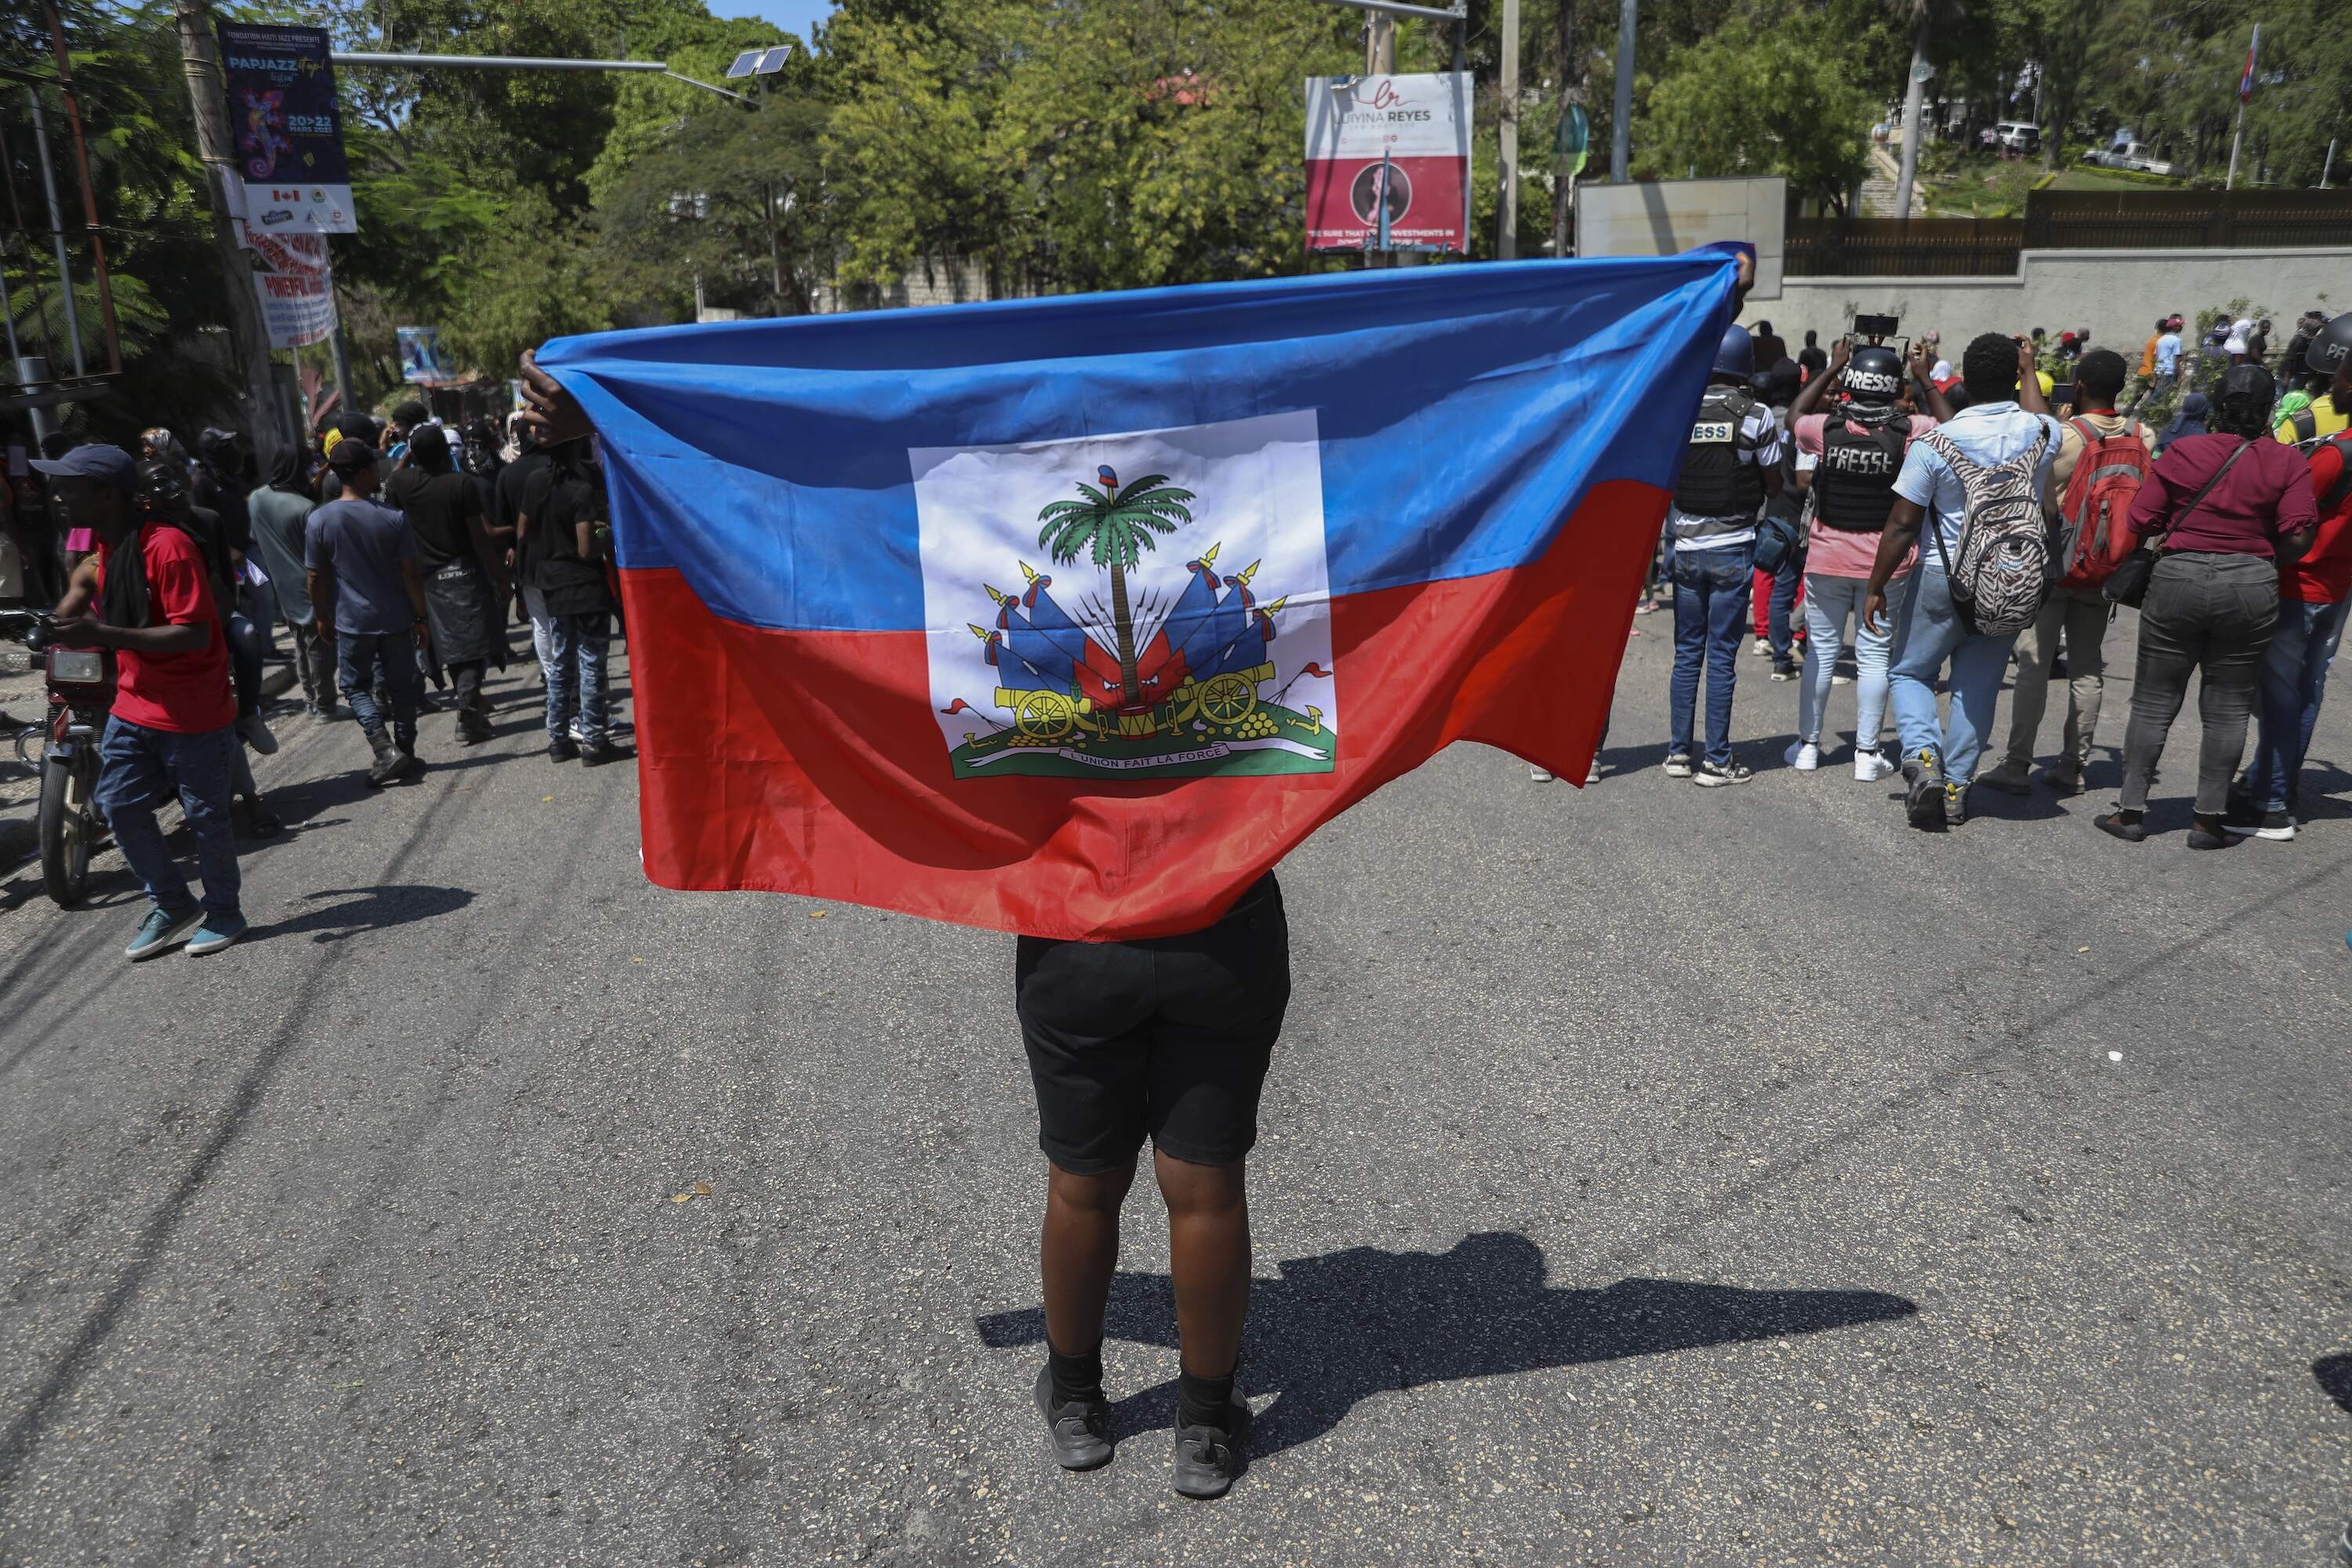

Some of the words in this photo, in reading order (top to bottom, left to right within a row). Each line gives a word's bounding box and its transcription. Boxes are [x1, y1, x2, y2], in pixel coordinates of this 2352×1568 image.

[262, 33, 278, 42] HAITI
[229, 56, 298, 71] PAPJAZZ
[1388, 111, 1431, 122] REYES
[1844, 368, 1899, 394] PRESSE
[1693, 426, 1727, 439] ESS
[1826, 446, 1894, 474] PRESSE
[1071, 753, 1120, 768] L'UNION
[1124, 758, 1152, 768] FAIT
[1156, 756, 1174, 764] LA
[1178, 748, 1223, 761] FORCE
